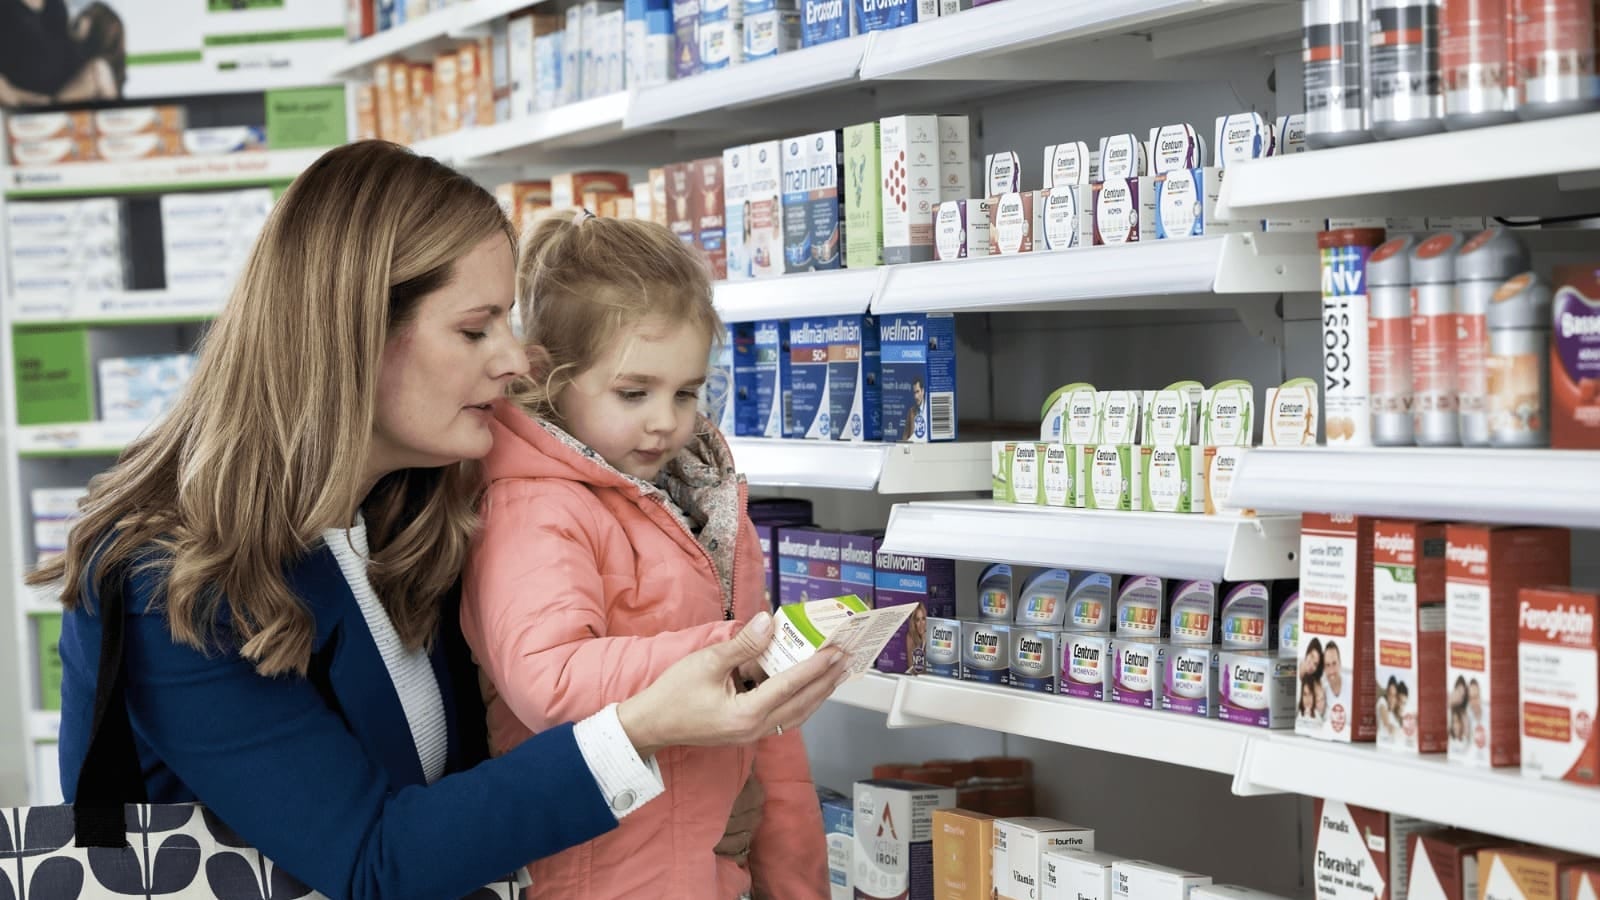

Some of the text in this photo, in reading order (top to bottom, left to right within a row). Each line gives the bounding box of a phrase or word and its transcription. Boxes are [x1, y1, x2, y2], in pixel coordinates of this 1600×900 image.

[806, 0, 842, 24] Eroxon
[1228, 129, 1251, 140] Centrum
[1289, 129, 1304, 140] Centr
[1161, 139, 1184, 151] Centrum
[1109, 148, 1127, 159] Centrum
[1057, 157, 1075, 167] Centrum
[995, 166, 1010, 175] Centrum
[785, 169, 807, 192] man
[810, 165, 832, 188] man
[1167, 179, 1190, 190] Centrum
[1103, 188, 1126, 199] Centrum
[1050, 194, 1069, 205] Centrum
[1001, 203, 1019, 214] Centrum
[812, 349, 826, 361] 50+
[1073, 405, 1091, 415] Centrum
[1109, 405, 1125, 415] Centrum
[1157, 404, 1176, 415] Centrum
[1216, 404, 1237, 415] Centrum
[1279, 403, 1303, 413] Centrum
[1016, 447, 1035, 458] Centrum
[1047, 449, 1065, 460] Centrum
[1096, 450, 1116, 461] Centrum
[1154, 450, 1176, 462] Centrum
[1216, 455, 1235, 466] Centru
[1101, 467, 1111, 477] kids
[1159, 468, 1171, 478] kids
[875, 552, 925, 572] wellwoman
[826, 566, 839, 577] 50+
[1520, 601, 1594, 640] Feroglobin
[783, 622, 805, 648] Centrum
[932, 626, 953, 640] Centrum
[974, 631, 998, 646] Centrum
[1020, 637, 1042, 653] Centrum
[1073, 643, 1099, 661] Centrum
[1124, 649, 1149, 667] Centrum
[1176, 656, 1203, 673] Centrum
[1234, 664, 1265, 683] Centrum
[1323, 816, 1349, 833] Floradix
[1056, 837, 1083, 846] fourfive
[876, 853, 898, 865] IRON
[1013, 870, 1035, 887] Vitamin
[1029, 886, 1036, 899] C
